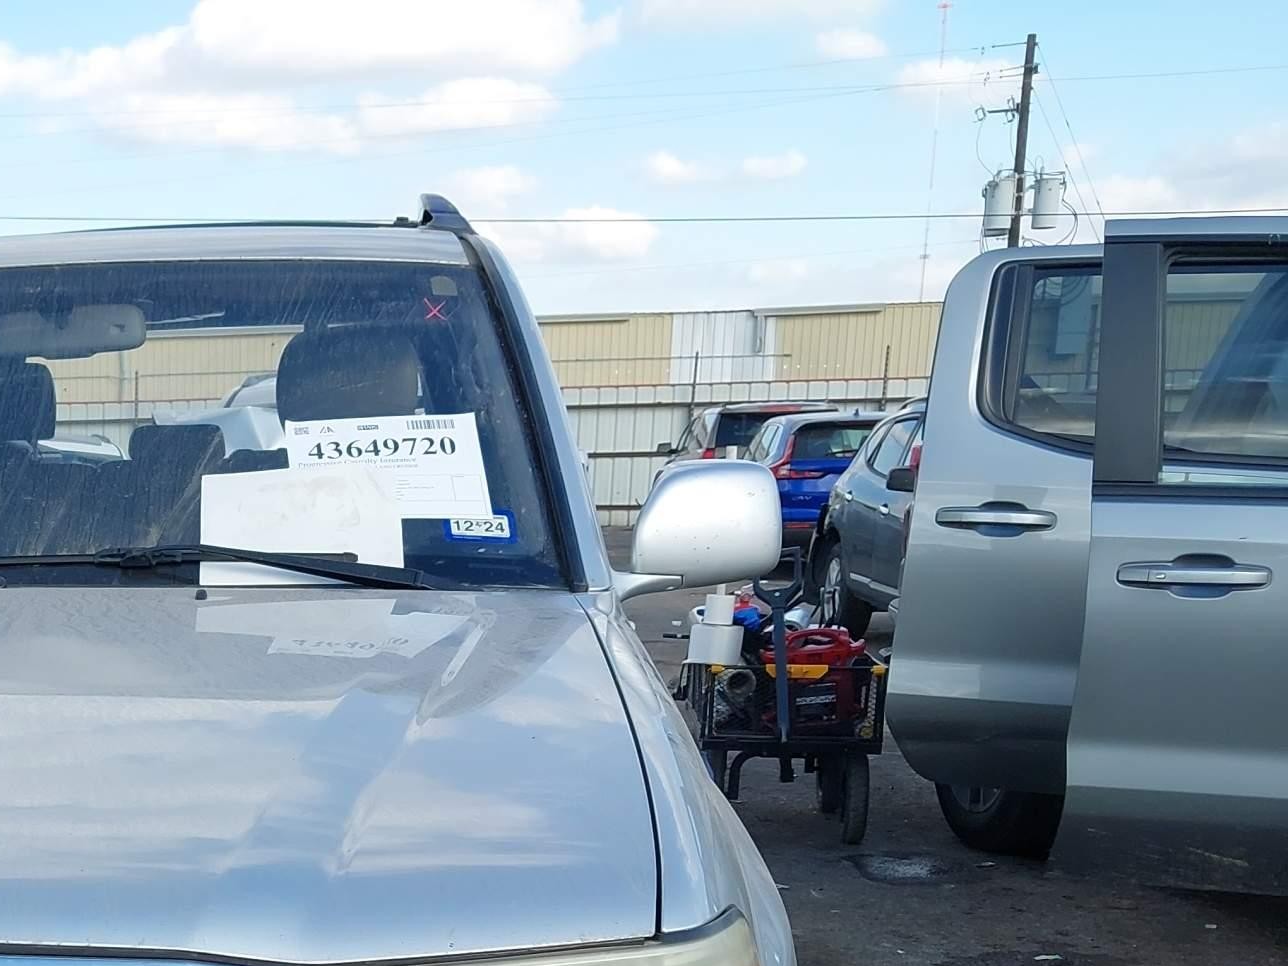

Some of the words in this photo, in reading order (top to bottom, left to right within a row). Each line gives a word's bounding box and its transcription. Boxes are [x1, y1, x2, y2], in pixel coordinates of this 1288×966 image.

[308, 436, 456, 459] 43649720
[452, 520, 474, 531] 12
[483, 521, 505, 533] 24
